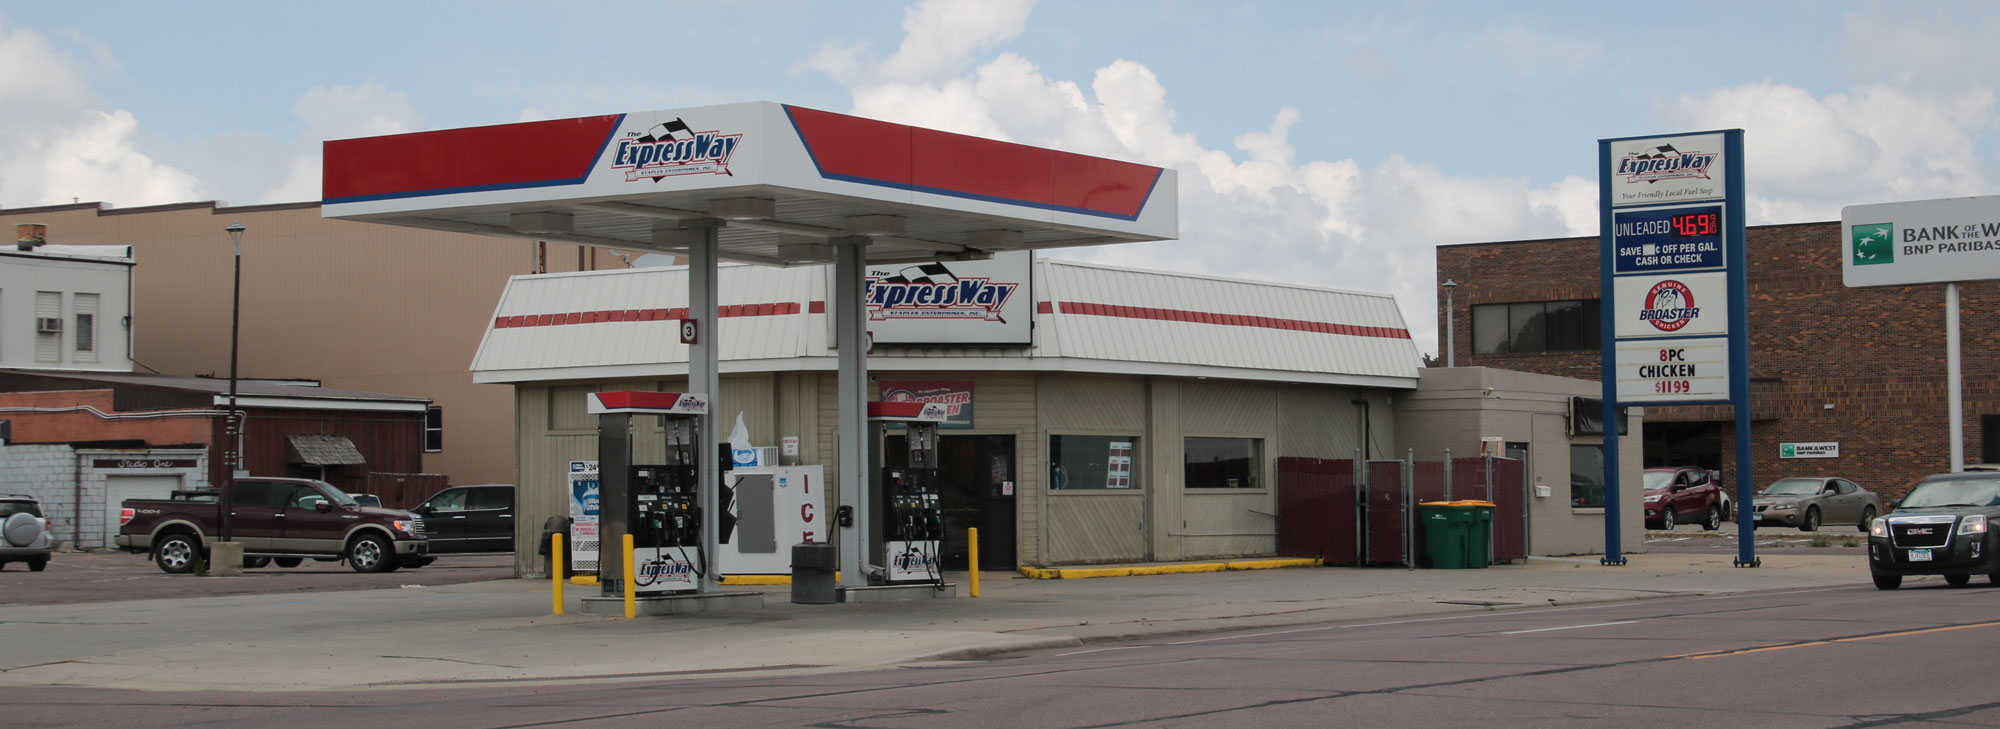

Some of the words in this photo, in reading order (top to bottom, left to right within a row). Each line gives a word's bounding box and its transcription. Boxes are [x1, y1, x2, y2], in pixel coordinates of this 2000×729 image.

[614, 134, 739, 168] ExpressWay
[1619, 154, 1714, 175] ExpressWay
[1638, 190, 1663, 199] Friendly
[1665, 189, 1682, 197] Local
[1699, 188, 1713, 196] Stop
[1615, 220, 1670, 237] UNLEADED
[1672, 214, 1709, 235] 4.69
[1903, 225, 1959, 242] BANK
[1620, 247, 1641, 256] SAVE
[1662, 245, 1678, 254] OFF
[1680, 243, 1696, 252] PER
[1698, 242, 1718, 251] GAL.
[1904, 245, 1934, 256] BNP
[1635, 256, 1658, 266] CASH
[1661, 255, 1672, 265] OR
[1674, 254, 1702, 264] CHECK
[866, 280, 1013, 310] ExpressWay
[1652, 282, 1687, 294] GENUINE
[1639, 307, 1700, 320] BROASTER
[686, 326, 692, 337] 3
[1655, 319, 1686, 330] CHICKEN
[1659, 348, 1685, 362] 8PC
[1639, 364, 1696, 378] CHICKEN
[1655, 380, 1690, 394] $1199
[117, 459, 147, 468] Studio
[153, 459, 173, 468] One
